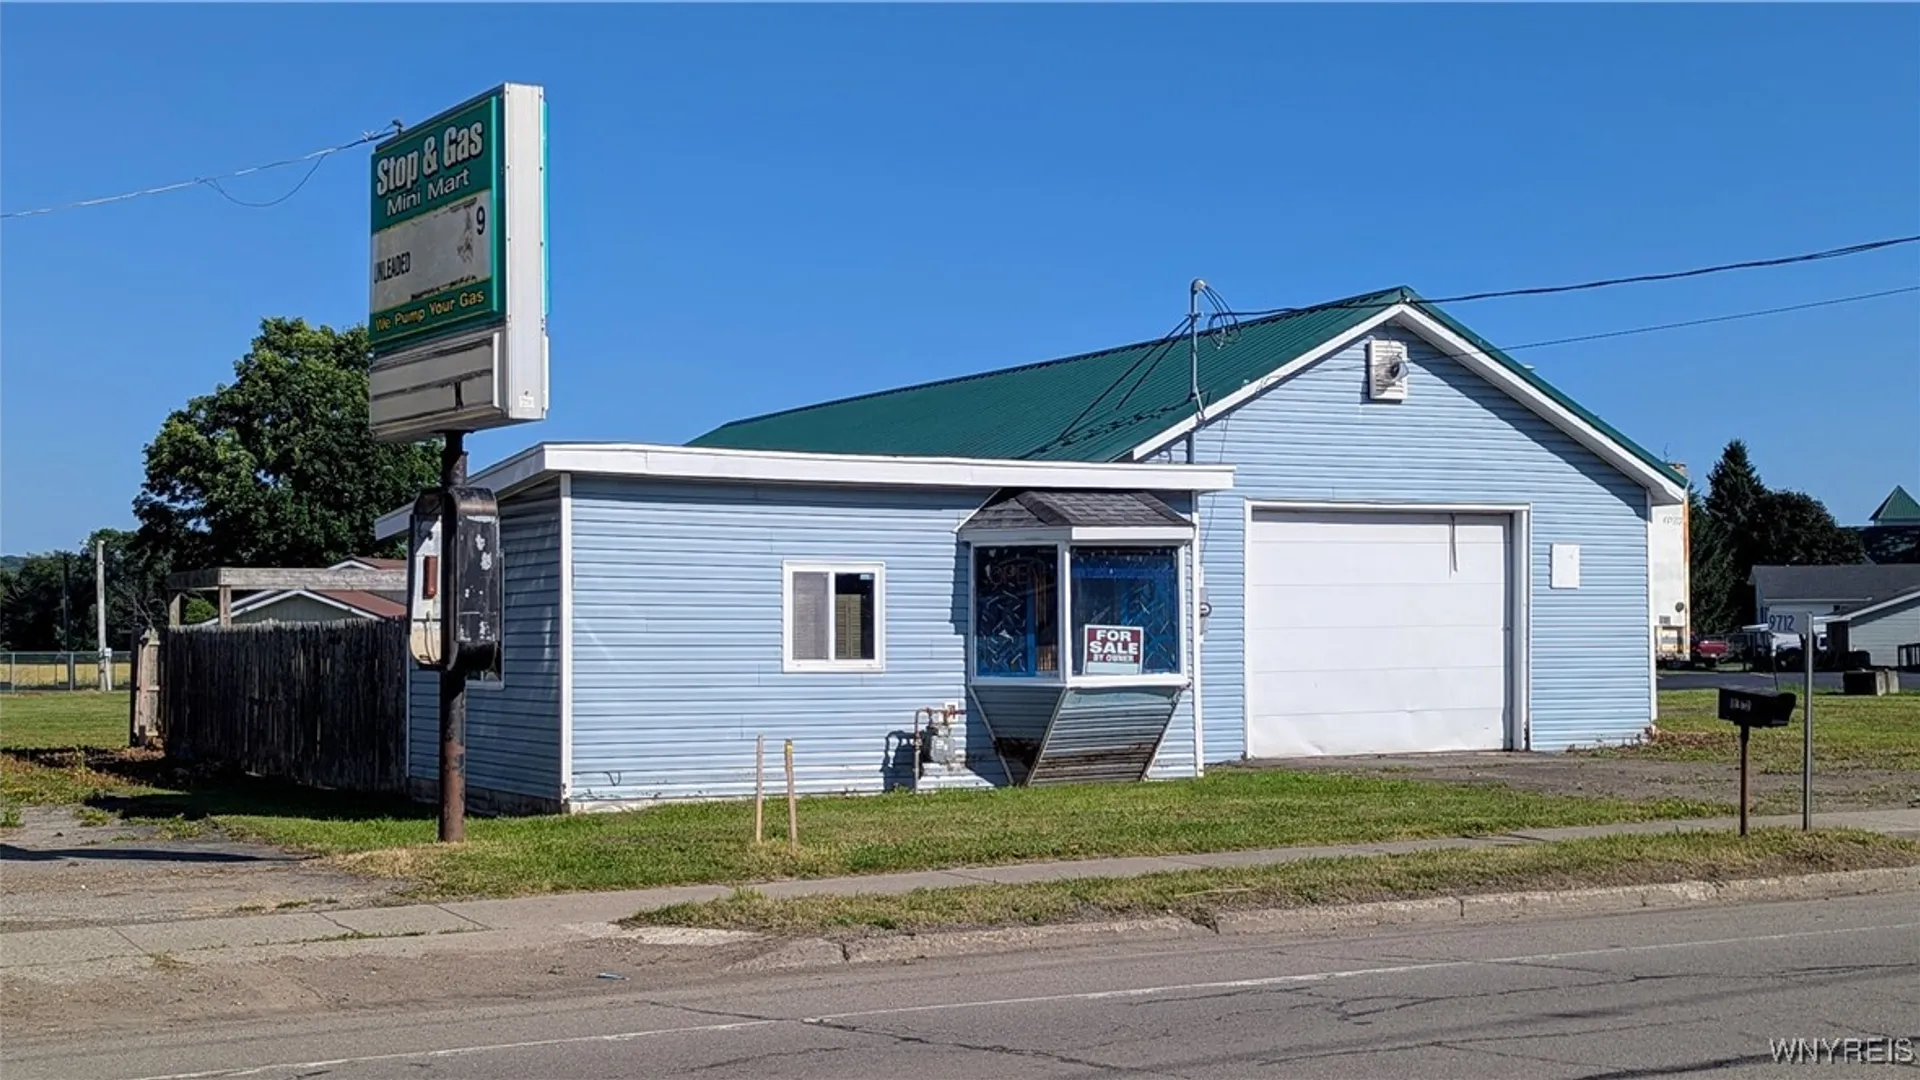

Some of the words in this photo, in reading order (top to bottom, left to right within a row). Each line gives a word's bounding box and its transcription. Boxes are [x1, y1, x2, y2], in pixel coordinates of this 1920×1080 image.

[377, 150, 419, 196] Stop
[422, 136, 439, 176] &
[443, 121, 483, 168] Gas
[386, 187, 421, 217] Mini
[427, 168, 470, 200] Mart
[476, 205, 486, 236] 9
[375, 317, 392, 332] We
[394, 307, 426, 326] Pump
[428, 298, 456, 316] Your
[459, 290, 485, 308] Gas
[1769, 614, 1796, 631] 9712
[1089, 640, 1139, 655] SALE
[1095, 629, 1132, 642] FOR
[1092, 653, 1105, 662] BY
[1105, 654, 1135, 662] OWNER
